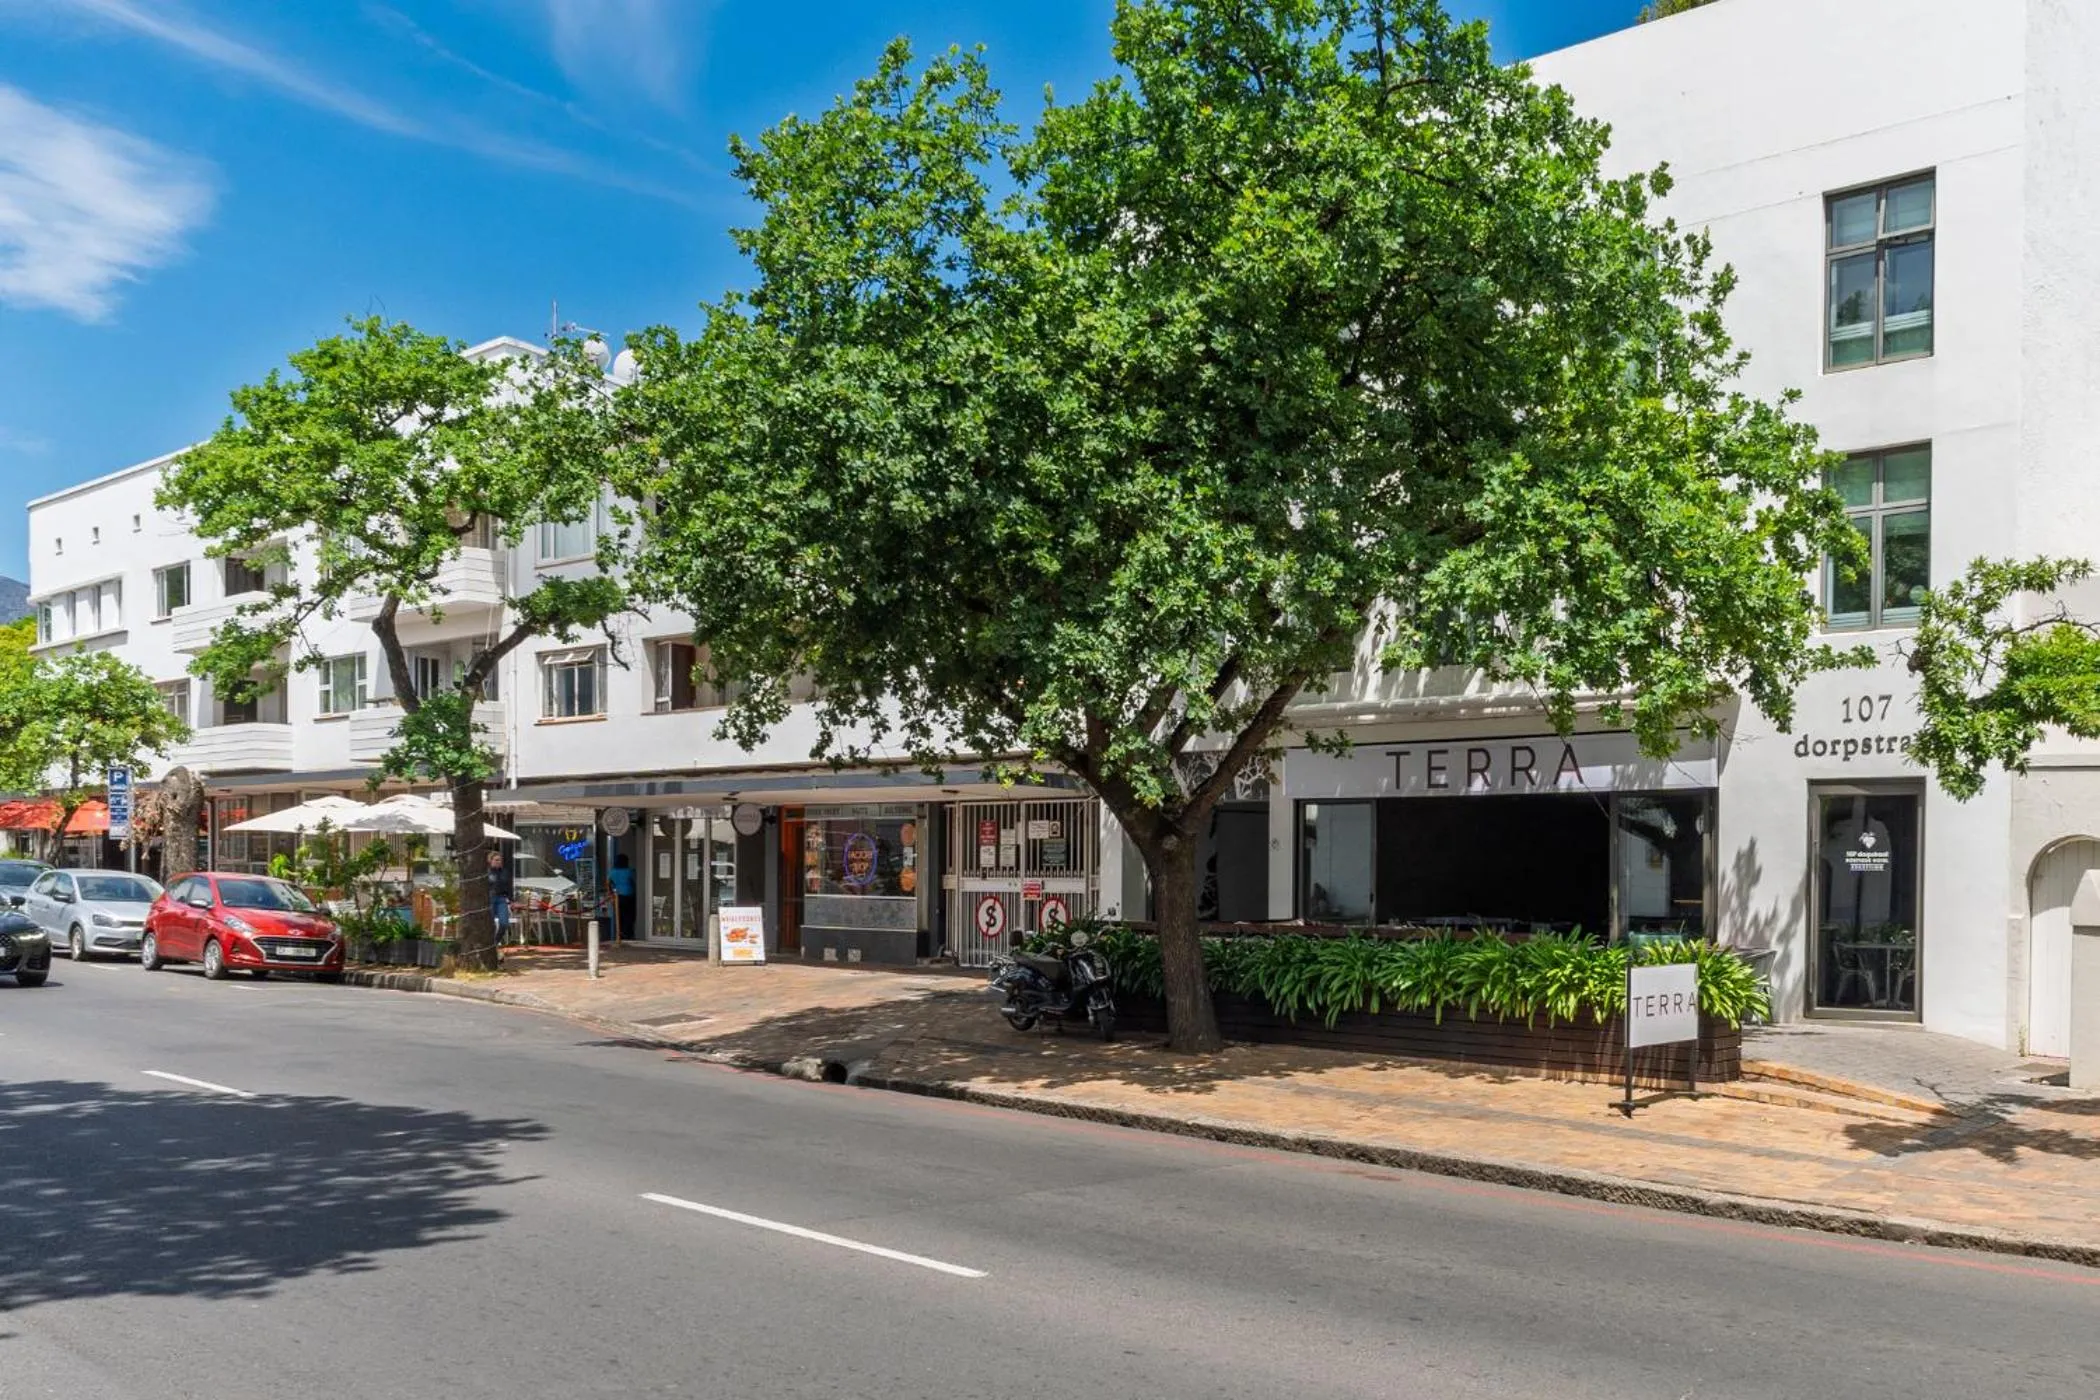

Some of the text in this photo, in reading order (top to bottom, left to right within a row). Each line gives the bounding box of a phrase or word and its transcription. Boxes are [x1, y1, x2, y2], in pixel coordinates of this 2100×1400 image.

[1841, 694, 1893, 724] 107
[1794, 733, 1912, 762] dorpstra
[113, 771, 125, 782] P
[1385, 743, 1584, 790] TERRA
[1632, 991, 1698, 1018] TERRA
